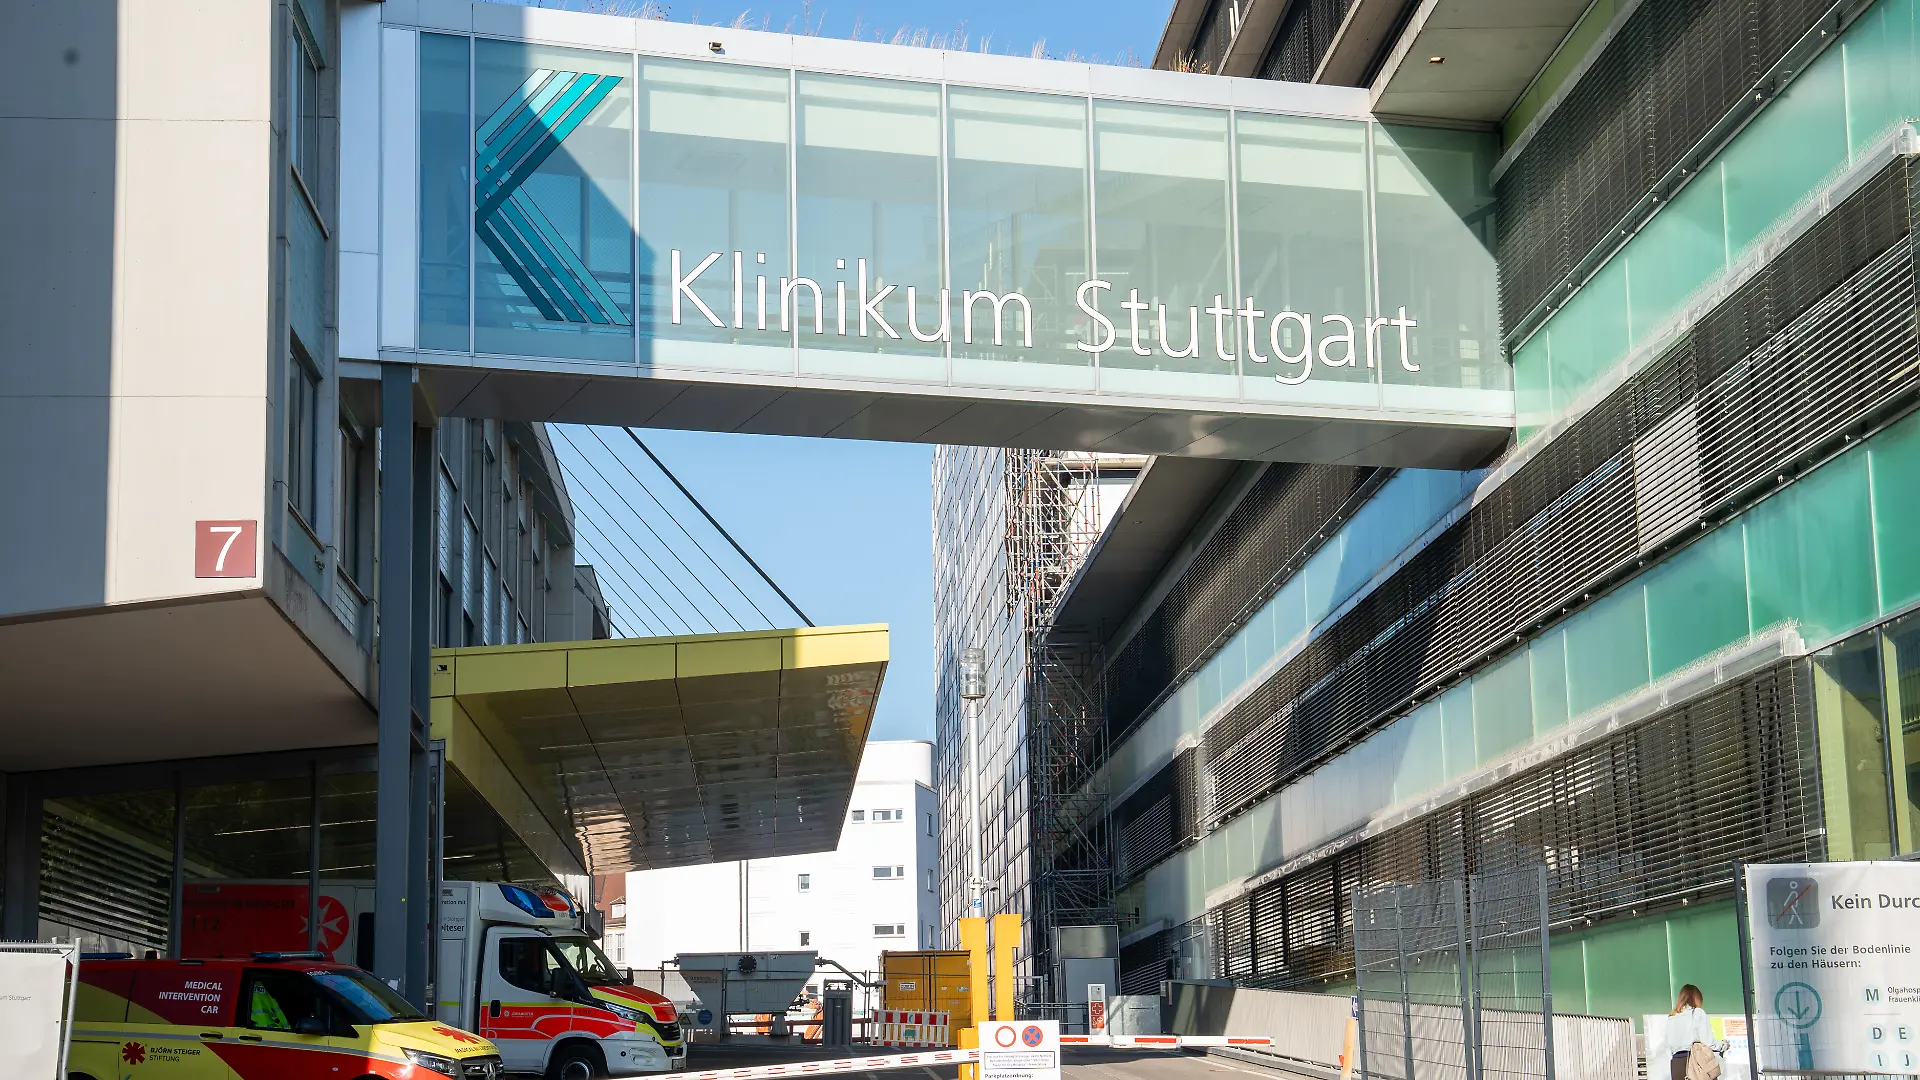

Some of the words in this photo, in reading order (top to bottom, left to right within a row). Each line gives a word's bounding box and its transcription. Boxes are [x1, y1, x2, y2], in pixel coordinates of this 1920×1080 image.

[670, 248, 1033, 349] Klinikum
[1075, 279, 1421, 385] Stuttgart
[209, 526, 242, 572] 7
[1831, 893, 1872, 910] Kein
[1878, 893, 1920, 909] Durc
[190, 917, 220, 932] 112
[1770, 945, 1808, 958] Folgen
[1811, 945, 1827, 955] Sie
[1830, 945, 1848, 955] der
[1852, 944, 1911, 954] Bodenlinie
[1787, 959, 1808, 969] den
[1811, 958, 1861, 969] Häusern:
[184, 980, 223, 991] MEDICAL
[158, 991, 221, 1003] INTERVENTION
[1865, 988, 1880, 1002] M
[201, 1005, 219, 1014] CAR
[1872, 1027, 1883, 1040] D
[1898, 1027, 1908, 1040] E
[150, 1046, 173, 1054] BJÖRN
[173, 1048, 201, 1056] STEIGER
[149, 1054, 180, 1062] STIFTUNG
[1877, 1054, 1883, 1067] I
[1904, 1054, 1910, 1067] J
